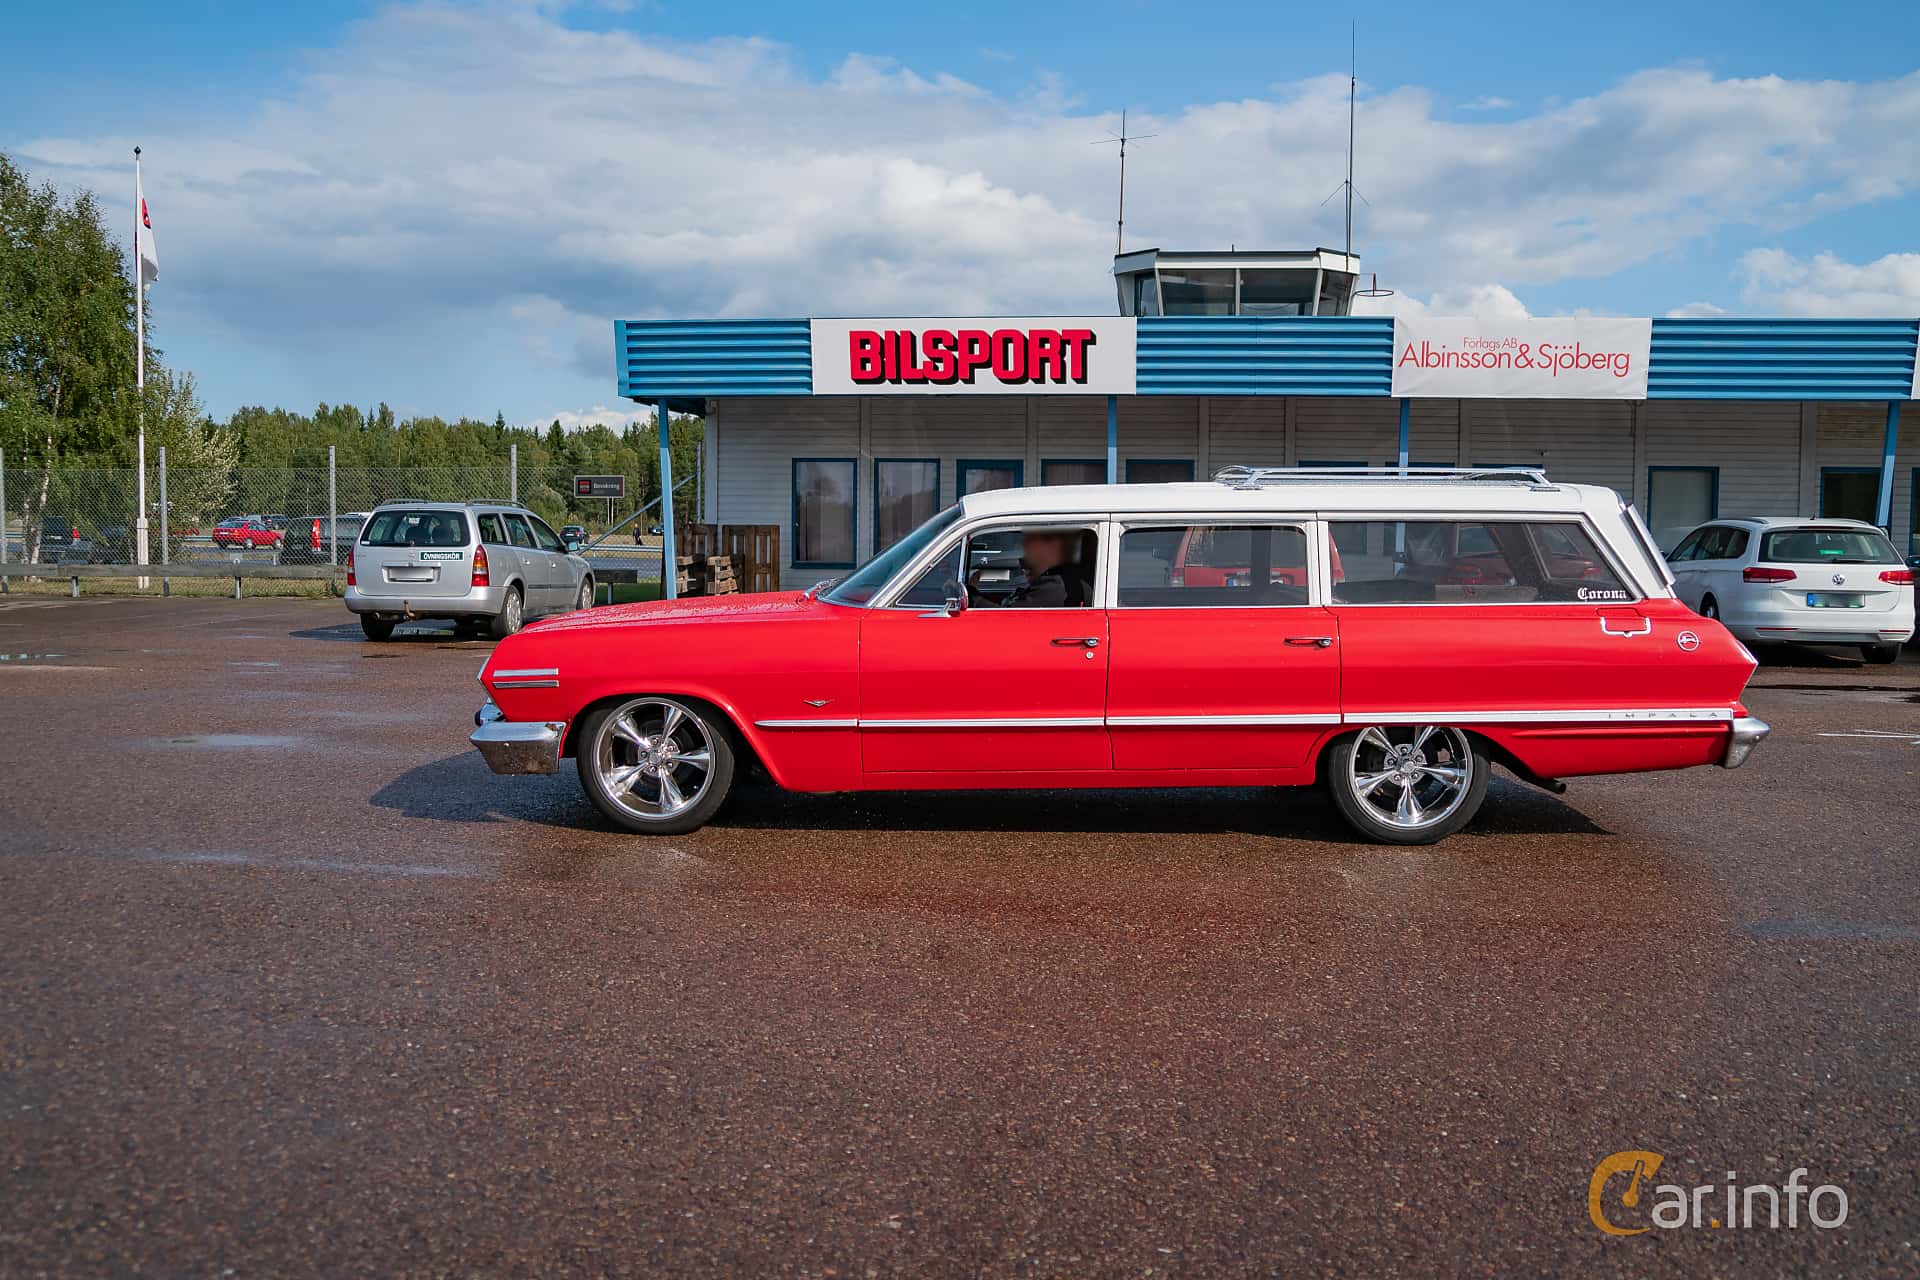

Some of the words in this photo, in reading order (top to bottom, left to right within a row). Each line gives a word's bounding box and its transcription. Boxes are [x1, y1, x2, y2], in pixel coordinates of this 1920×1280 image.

[1502, 338, 1518, 349] AB
[849, 329, 1097, 385] BILSPORT
[1577, 587, 1627, 600] Corona
